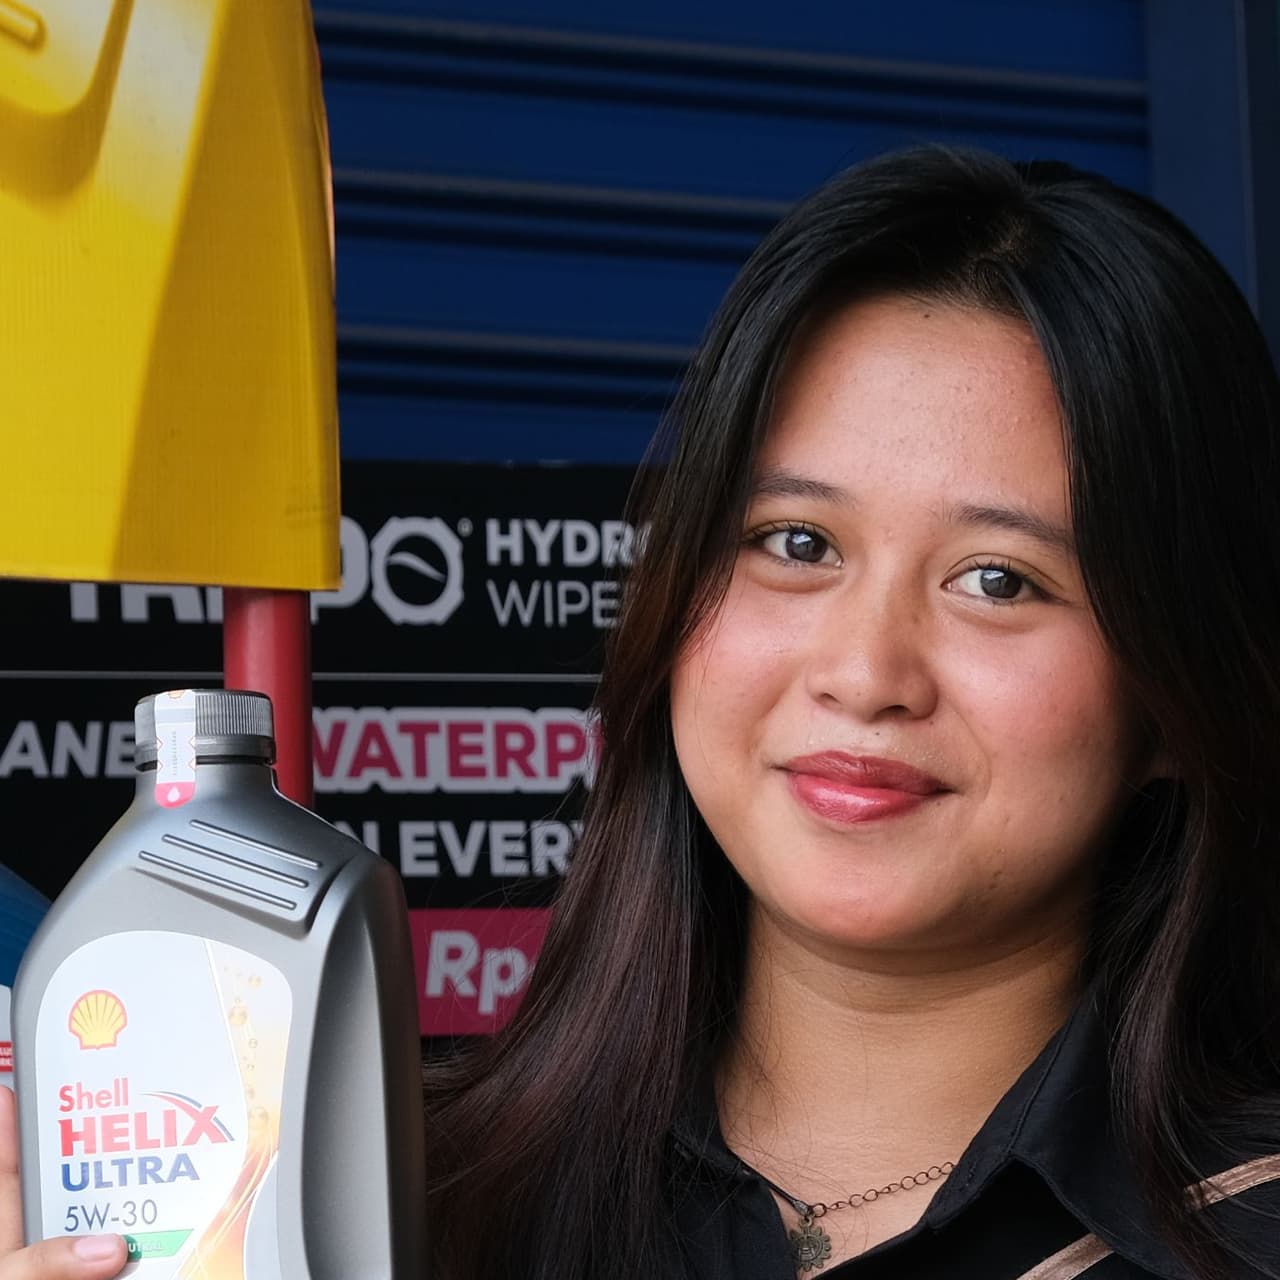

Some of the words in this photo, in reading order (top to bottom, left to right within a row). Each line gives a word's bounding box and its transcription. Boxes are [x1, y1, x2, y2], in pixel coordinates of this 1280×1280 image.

[487, 520, 642, 566] HYDR
[487, 581, 622, 628] WIPE
[312, 714, 604, 784] ATERP
[58, 1077, 129, 1113] Shell
[58, 1098, 235, 1157] HELIX
[61, 1153, 200, 1192] ULTRA
[64, 1199, 158, 1232] 5W-30
